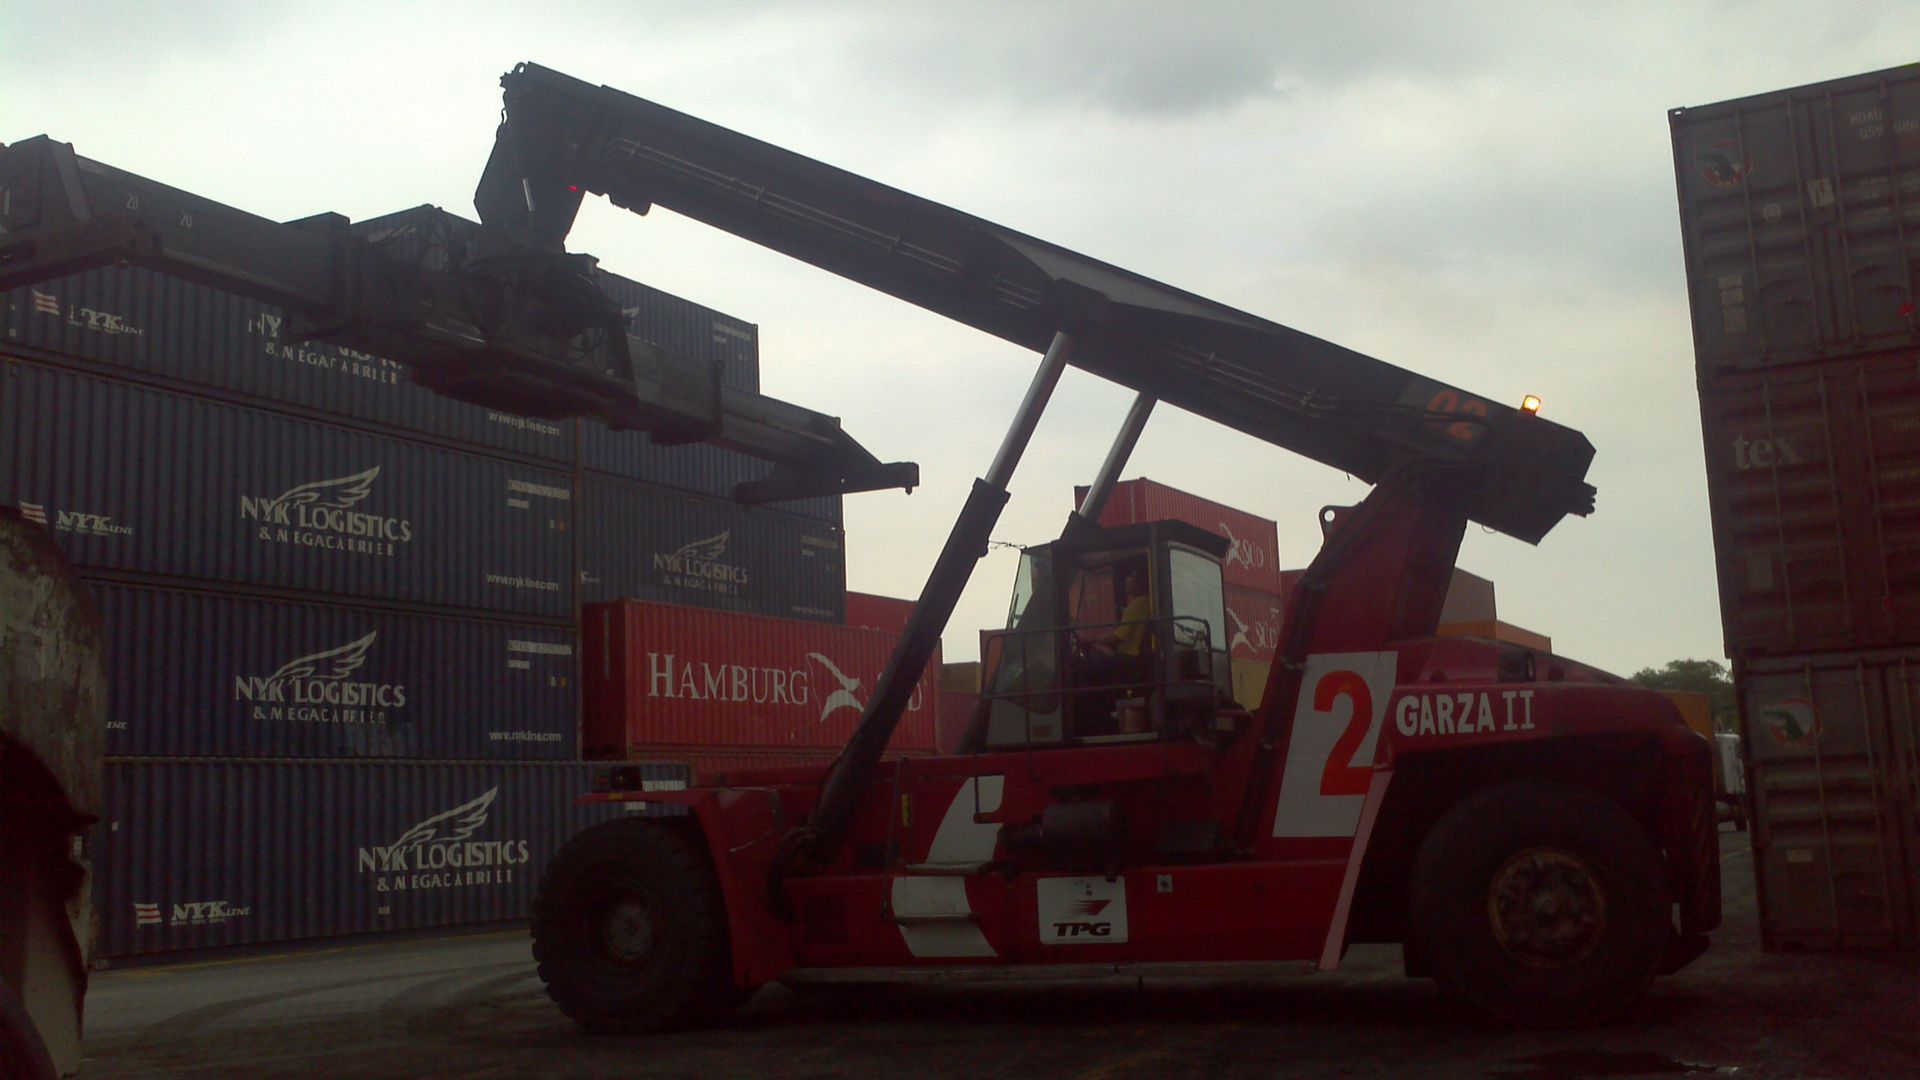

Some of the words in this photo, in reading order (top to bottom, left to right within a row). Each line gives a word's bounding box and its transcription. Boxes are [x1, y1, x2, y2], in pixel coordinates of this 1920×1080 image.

[1733, 433, 1804, 470] tex
[56, 509, 111, 530] NYK
[240, 495, 291, 525] NYK
[299, 503, 412, 542] LOGISTICS
[259, 527, 272, 541] &
[235, 675, 286, 702] NYK
[294, 678, 406, 708] LOGISTICS
[647, 652, 809, 705] HAMBURG
[253, 706, 266, 720] &
[1396, 692, 1496, 737] GARZA
[1502, 690, 1536, 732] II
[1314, 670, 1373, 796] 2
[359, 847, 408, 873] NYK
[416, 839, 530, 870] LOGISTICS
[377, 877, 390, 892] &
[170, 901, 228, 921] NYK
[1053, 922, 1111, 937] TPG
